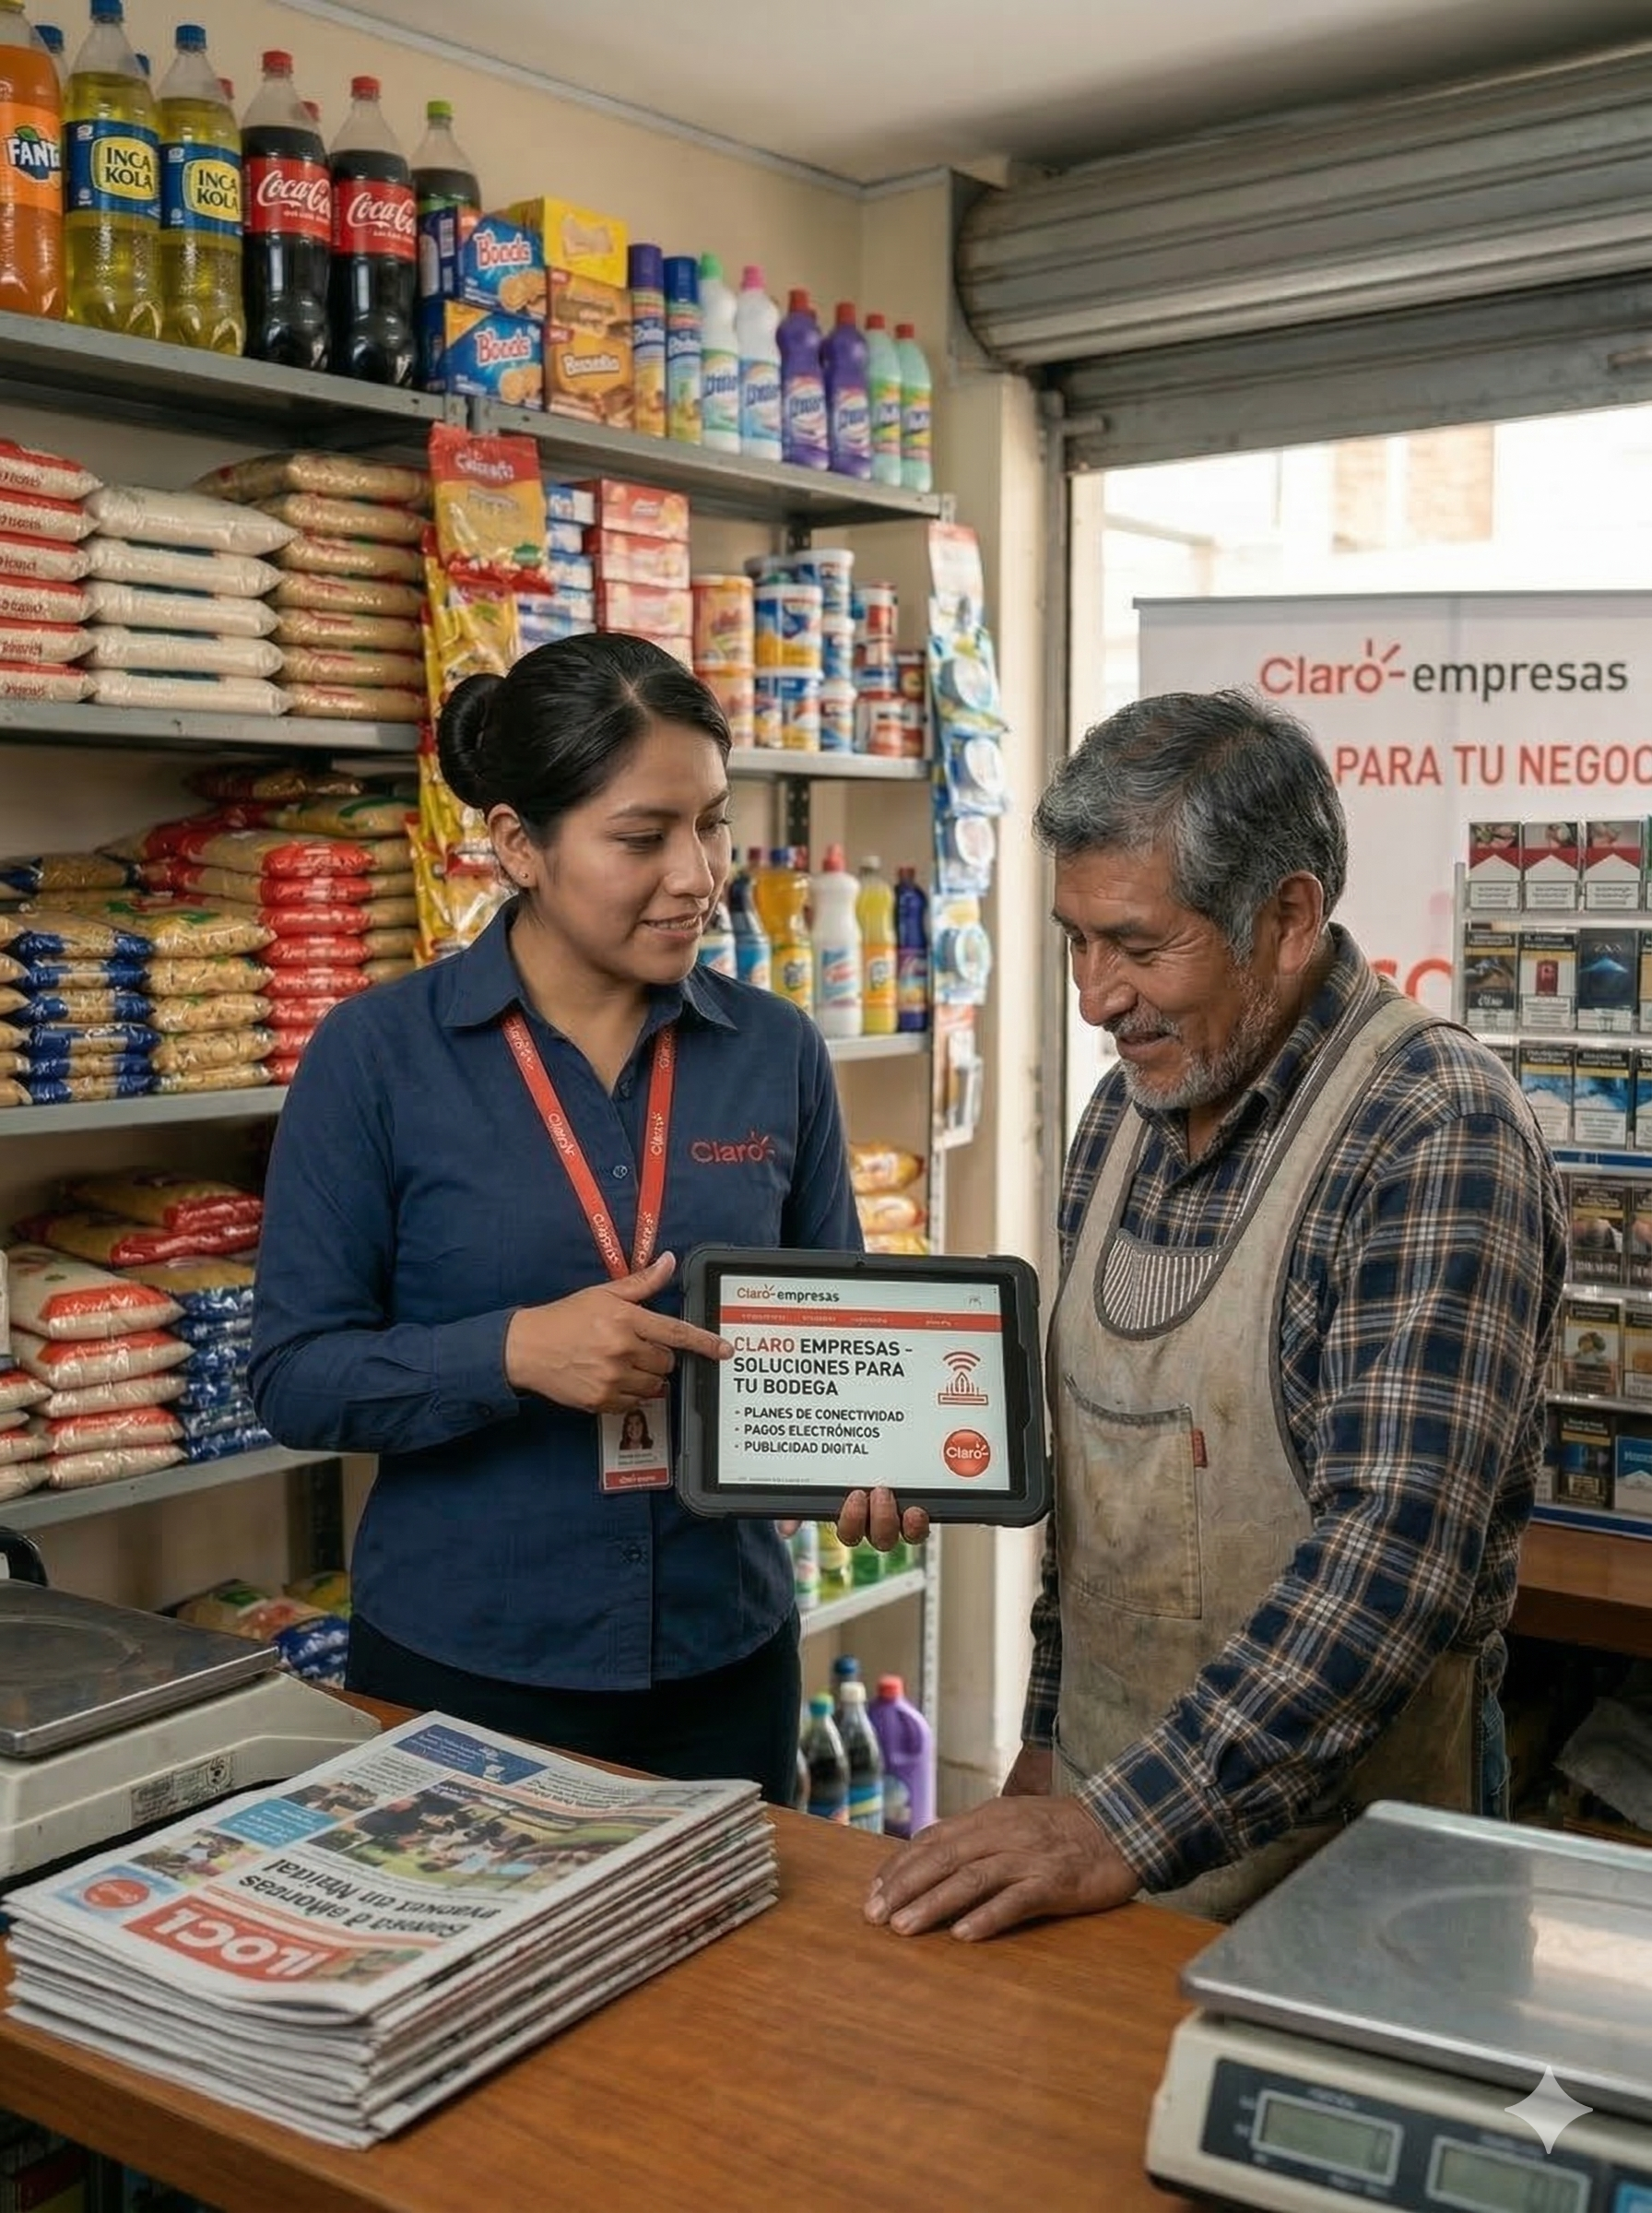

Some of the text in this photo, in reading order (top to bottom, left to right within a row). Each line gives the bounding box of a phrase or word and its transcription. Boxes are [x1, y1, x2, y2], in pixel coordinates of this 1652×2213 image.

[106, 147, 151, 172] INCA
[105, 166, 153, 192] KOLA
[198, 169, 238, 190] INCA
[196, 188, 240, 214] KOLA
[1260, 638, 1628, 703] Claro empresas
[1337, 745, 1442, 786] PARA
[1453, 745, 1504, 785] TU
[692, 1131, 775, 1163] Claro
[737, 1284, 840, 1304] Claro empresas
[734, 1336, 795, 1353] CLARO
[800, 1338, 901, 1356] EMPRESAS
[733, 1357, 905, 1378] SOLUCIONES PARA
[733, 1378, 839, 1396] TU BODEGA
[744, 1407, 904, 1422] PLANES DE CONECTIVIDAD
[744, 1423, 880, 1438] PAGOS ELECTRÓNICOS
[744, 1441, 868, 1455] PUBLICIDAD DIGITAL
[946, 1442, 988, 1460] Claro
